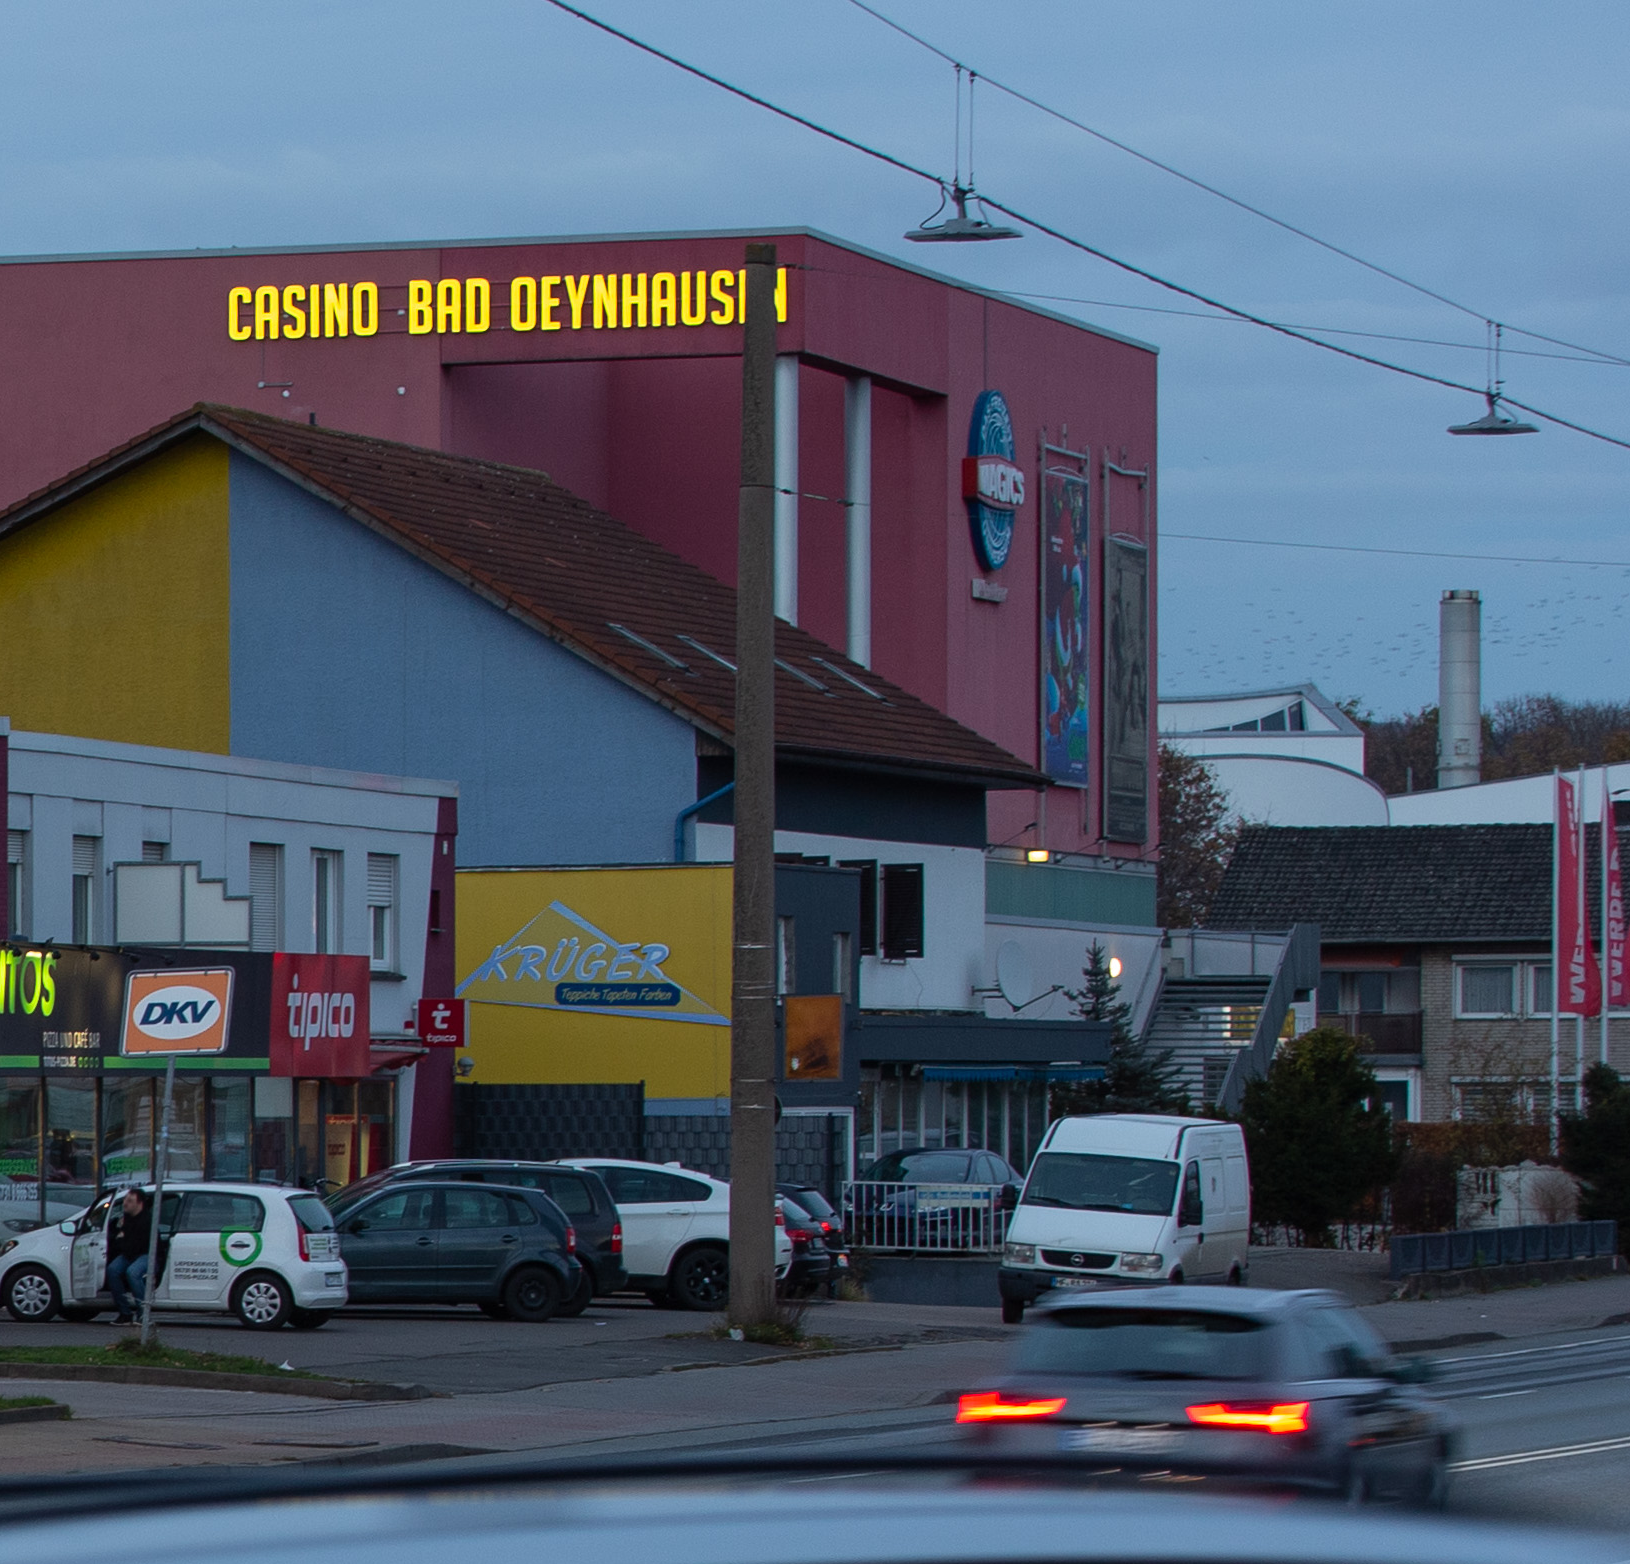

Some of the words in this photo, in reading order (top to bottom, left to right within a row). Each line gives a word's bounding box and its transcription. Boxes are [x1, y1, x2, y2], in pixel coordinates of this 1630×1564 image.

[228, 282, 379, 341] CASINO
[408, 278, 491, 336] BAD
[479, 936, 670, 982] KRÜGER
[139, 1000, 216, 1026] DKV
[287, 973, 356, 1051] tipico
[425, 1032, 457, 1043] tipico
